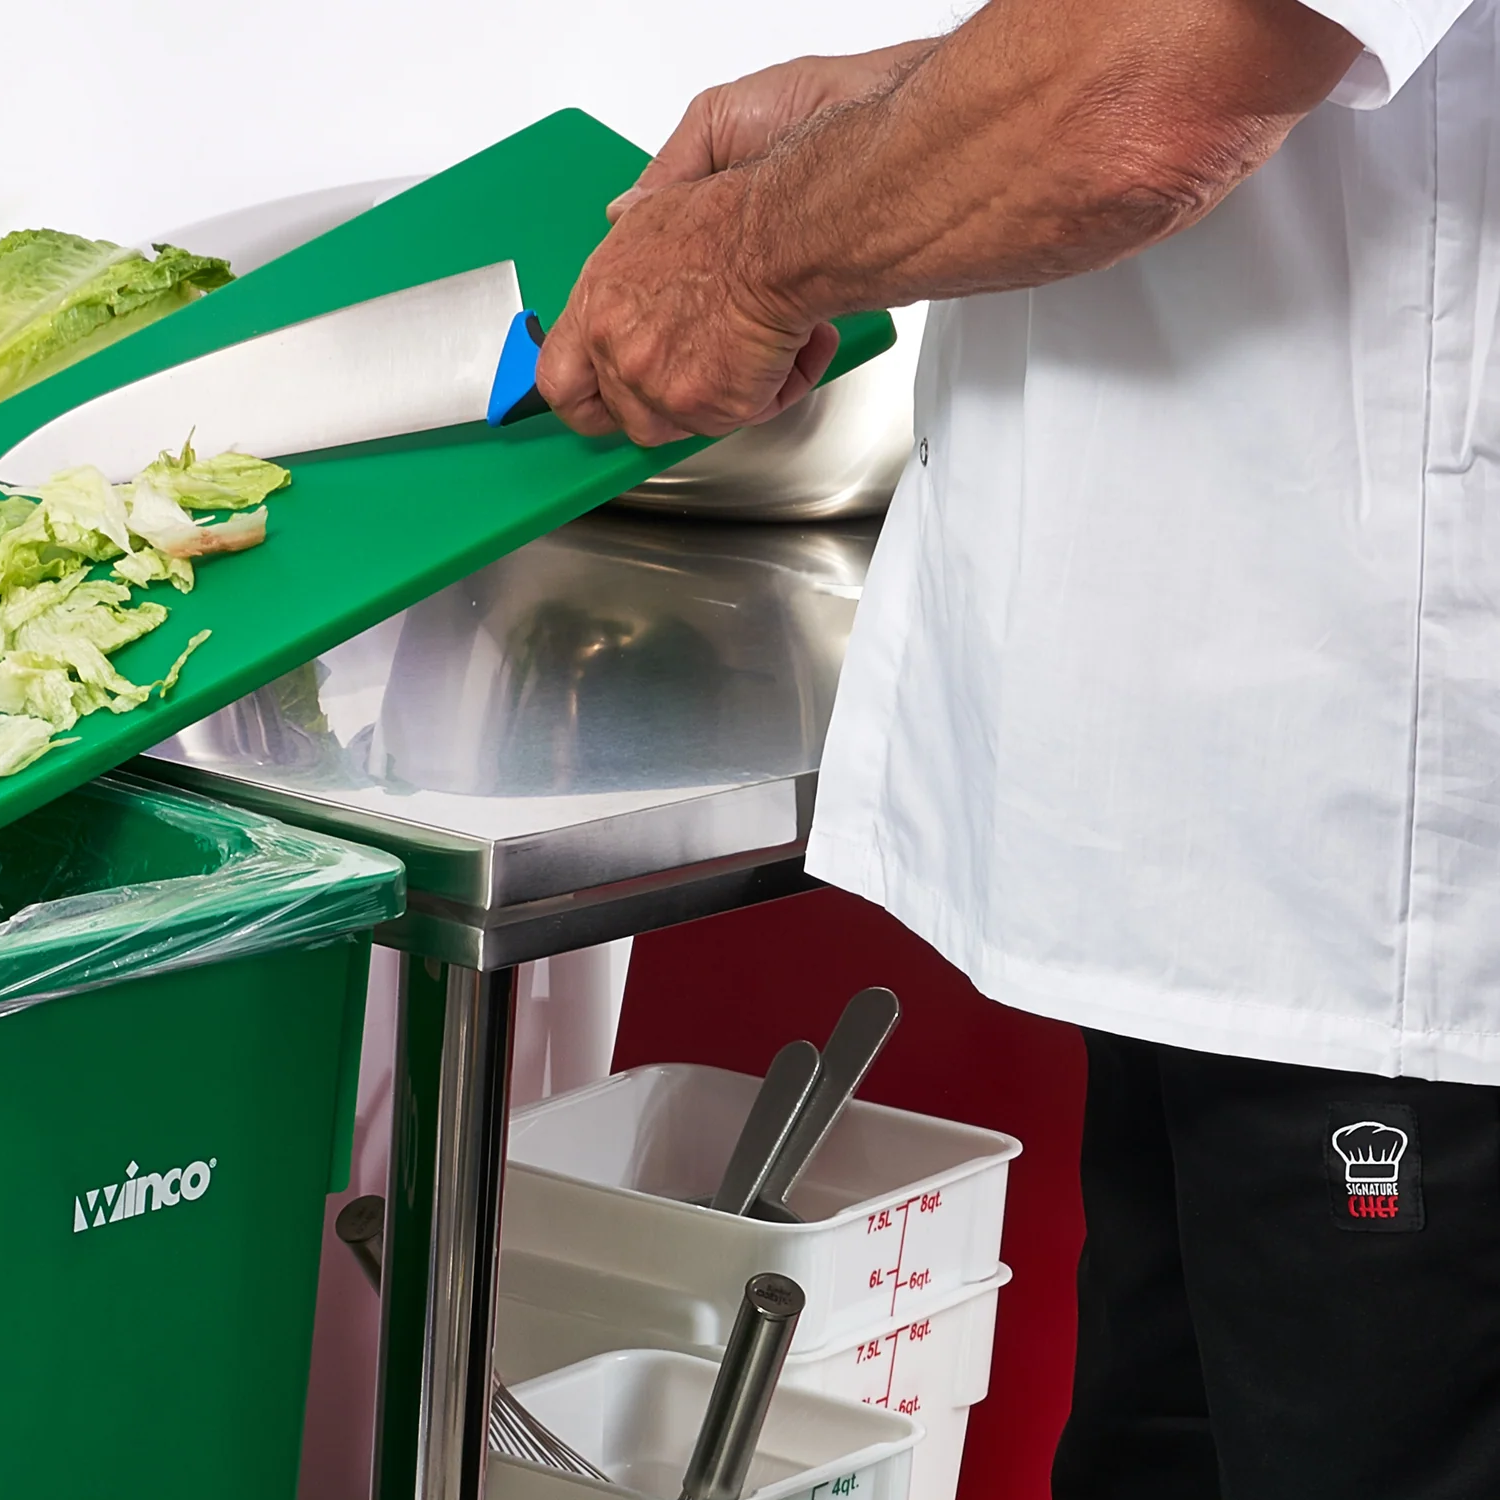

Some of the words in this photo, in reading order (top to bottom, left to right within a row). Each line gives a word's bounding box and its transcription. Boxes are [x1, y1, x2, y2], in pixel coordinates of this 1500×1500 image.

[1345, 1183, 1399, 1195] SIGNATURE
[920, 1191, 942, 1213] 8qt.
[1347, 1195, 1399, 1218] CHEF
[867, 1209, 892, 1235] 7.5L
[869, 1269, 884, 1288] 6L
[909, 1268, 931, 1290] 6qt.
[909, 1319, 931, 1341] 8qt.
[856, 1339, 881, 1365] 7.5L
[832, 1473, 859, 1496] 4qt.
